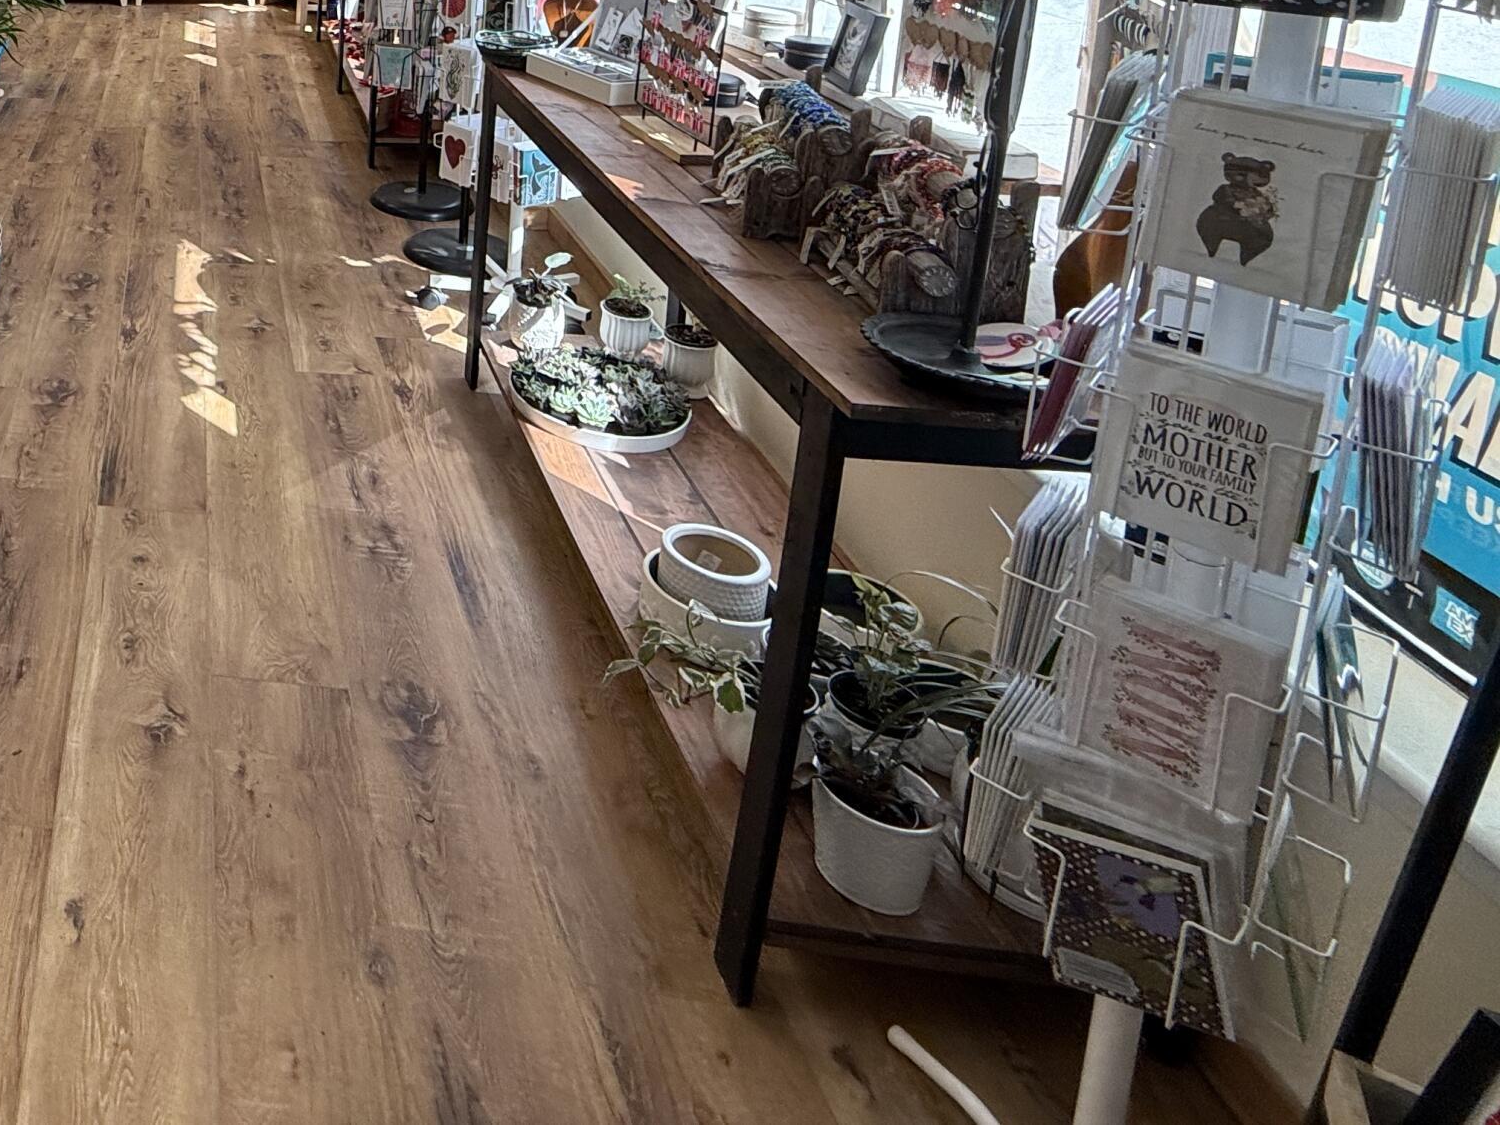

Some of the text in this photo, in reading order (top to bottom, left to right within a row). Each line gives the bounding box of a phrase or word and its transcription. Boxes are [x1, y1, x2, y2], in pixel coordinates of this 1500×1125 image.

[1151, 392, 1268, 444] TO THE WORLD
[1138, 446, 1257, 495] BUT TO YOUR FAMILY
[1143, 423, 1257, 481] MOTHER
[1135, 470, 1248, 527] WORLD
